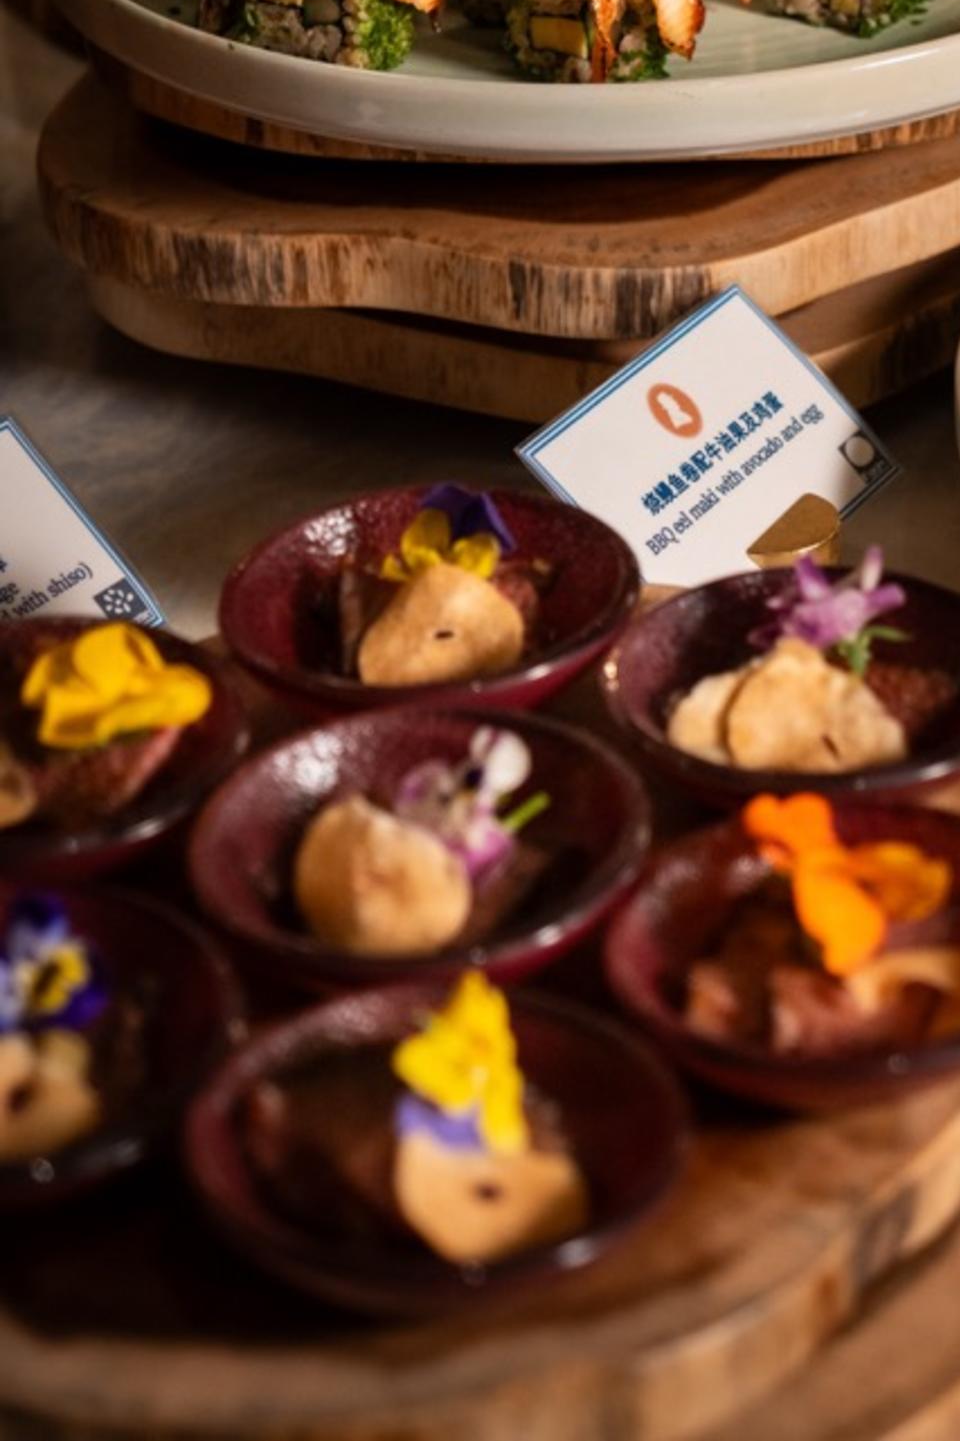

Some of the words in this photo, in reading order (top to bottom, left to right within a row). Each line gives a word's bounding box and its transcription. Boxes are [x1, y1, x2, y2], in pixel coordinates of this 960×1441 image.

[645, 527, 680, 556] BBQ
[673, 511, 694, 534] eel
[689, 488, 721, 521] maki
[716, 470, 745, 496] with
[740, 436, 784, 476] avocado
[781, 416, 804, 442] and
[801, 404, 824, 425] egg
[13, 588, 49, 617] with
[47, 562, 94, 598] shiso)
